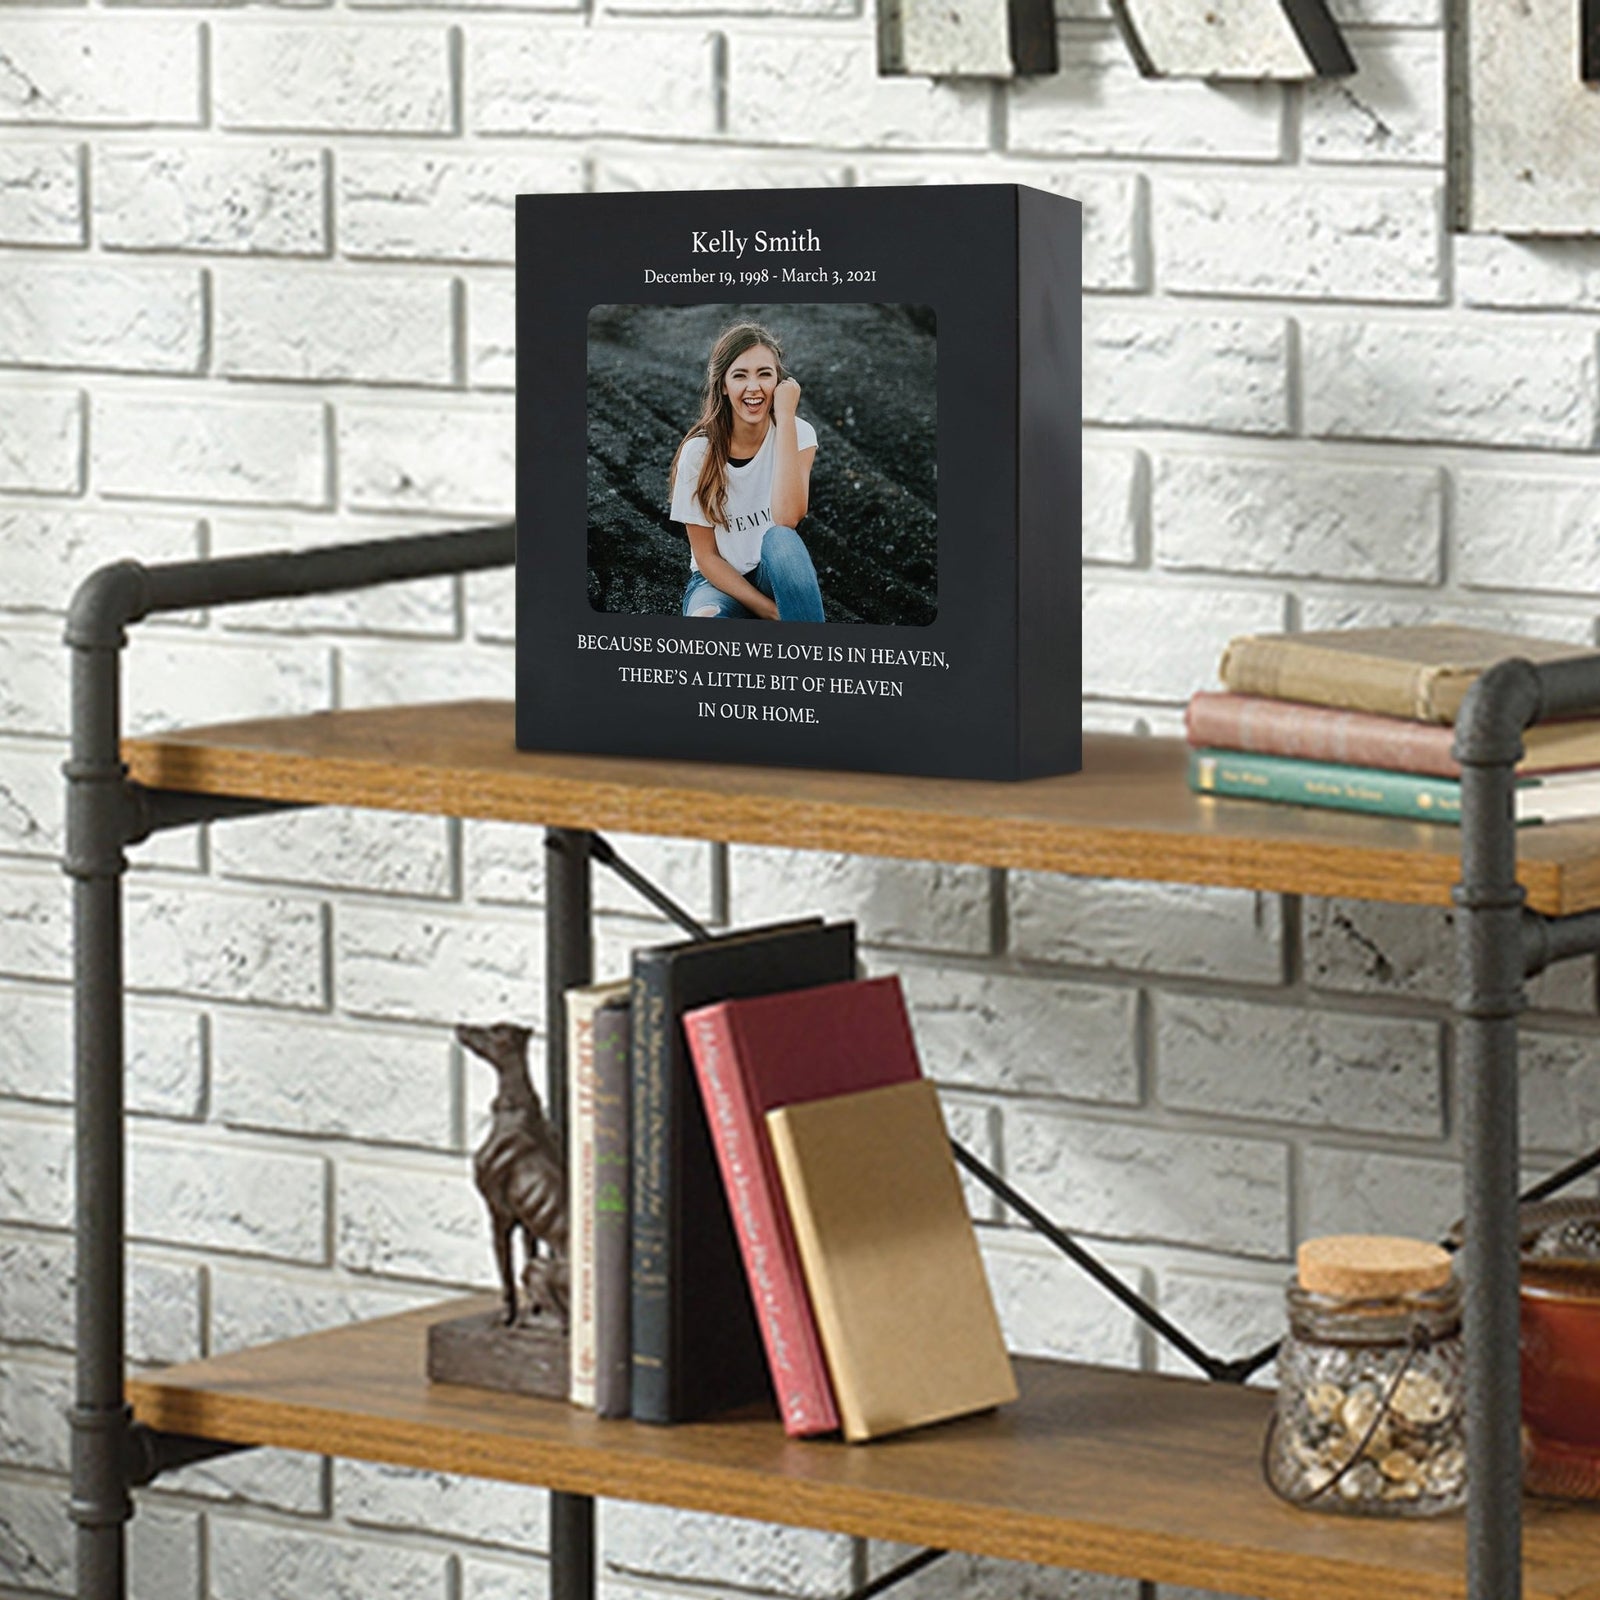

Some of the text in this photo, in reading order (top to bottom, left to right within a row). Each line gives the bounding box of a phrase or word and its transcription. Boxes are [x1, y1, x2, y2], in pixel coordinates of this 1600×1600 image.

[691, 228, 822, 260] Kelly Smith
[644, 267, 716, 284] December
[718, 271, 736, 286] 19,
[739, 268, 770, 286] 1998
[781, 266, 829, 283] March
[831, 270, 843, 286] 3,
[846, 270, 877, 282] 2021
[577, 633, 950, 670] BECAUSE SOMEONE WE LOVE IS IN HEAVEN,
[618, 666, 904, 697] THERE’S A LITTLE BIT OF HEAVEN
[698, 701, 820, 724] IN OUR HOME.
